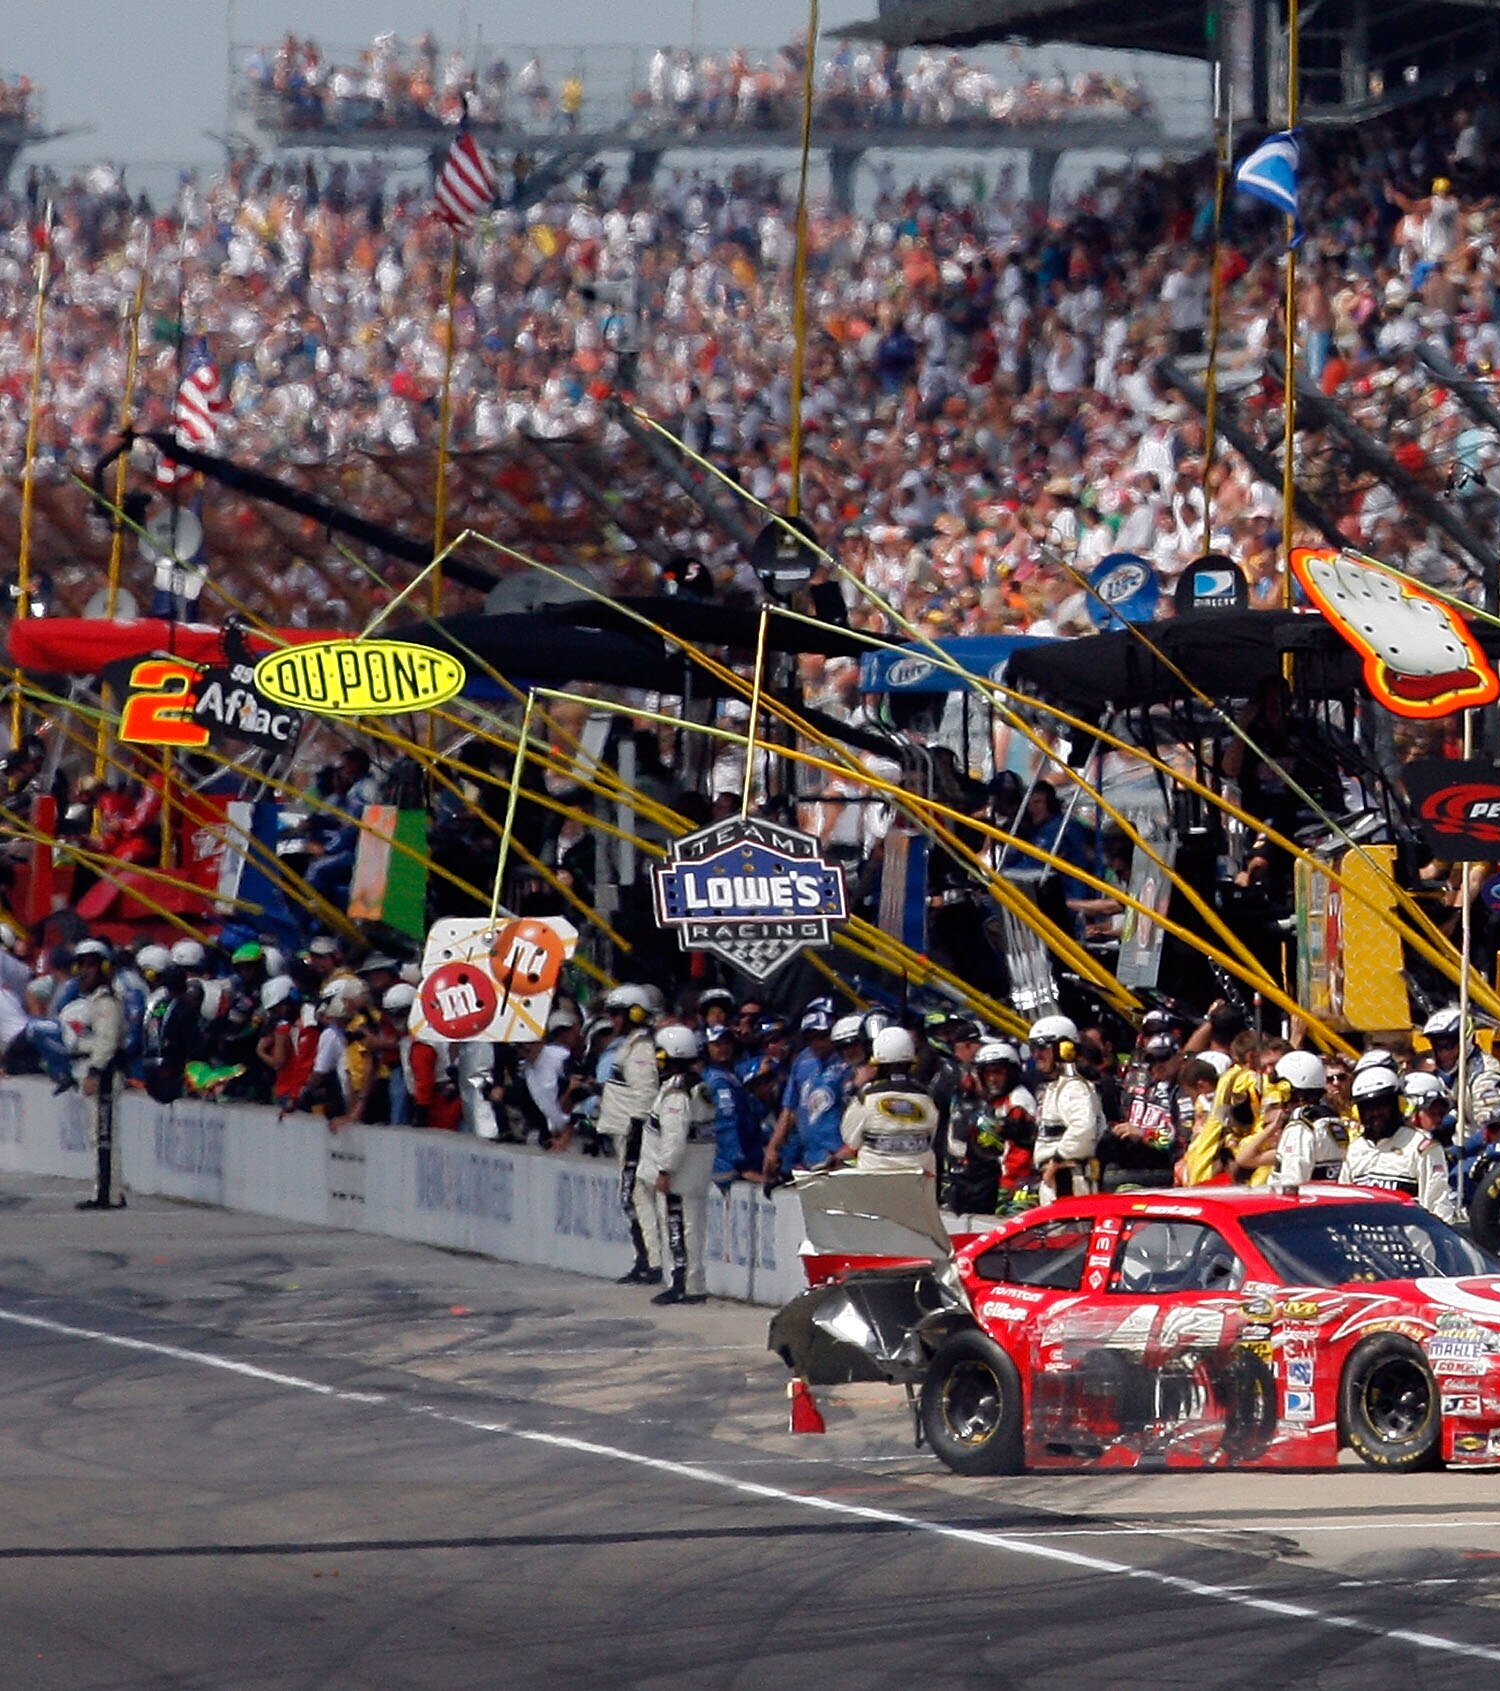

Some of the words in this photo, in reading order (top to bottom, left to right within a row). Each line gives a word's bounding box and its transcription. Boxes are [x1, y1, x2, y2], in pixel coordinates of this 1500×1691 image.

[119, 660, 210, 746] 2
[194, 682, 291, 740] Aflac
[691, 825, 795, 856] TEAM
[684, 870, 821, 909] LOWE'S
[692, 923, 819, 938] RACING
[435, 982, 486, 1022] m
[1430, 1343, 1482, 1357] MAHLE
